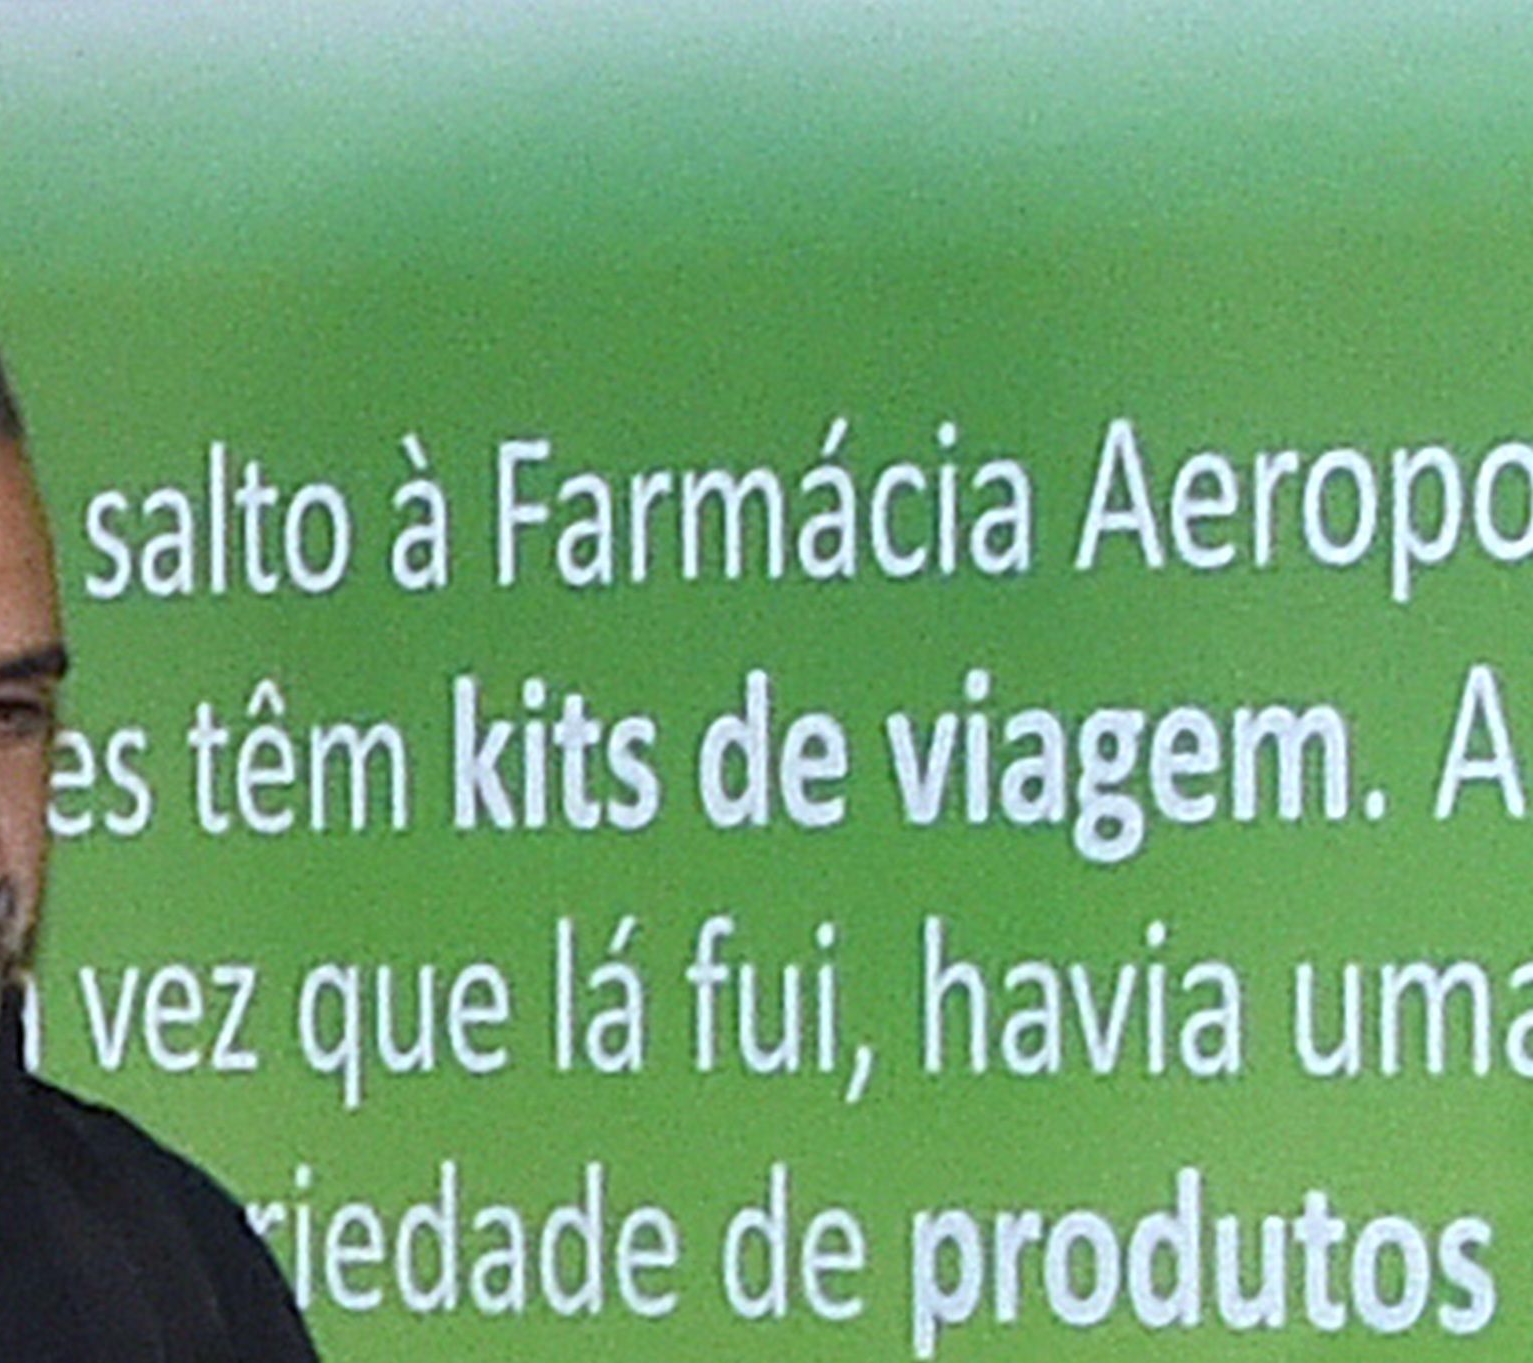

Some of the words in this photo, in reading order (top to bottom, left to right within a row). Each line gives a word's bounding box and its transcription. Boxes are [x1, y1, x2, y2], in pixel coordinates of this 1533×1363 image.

[84, 441, 350, 599] salto
[390, 433, 448, 589] à
[498, 417, 1032, 587] Farmácia
[1074, 417, 1533, 602] Aeropo
[47, 724, 153, 837] es
[188, 678, 408, 834] têm
[452, 673, 662, 831] kits
[698, 668, 850, 828] de
[885, 667, 1386, 864] viagem.
[1434, 664, 1528, 822] A
[79, 963, 260, 1071] vez
[300, 963, 509, 1109] que
[556, 916, 644, 1072] lá
[685, 916, 872, 1103] fui,
[922, 915, 1242, 1076] havia
[722, 1161, 866, 1320] de
[912, 1165, 1497, 1361] produtos
